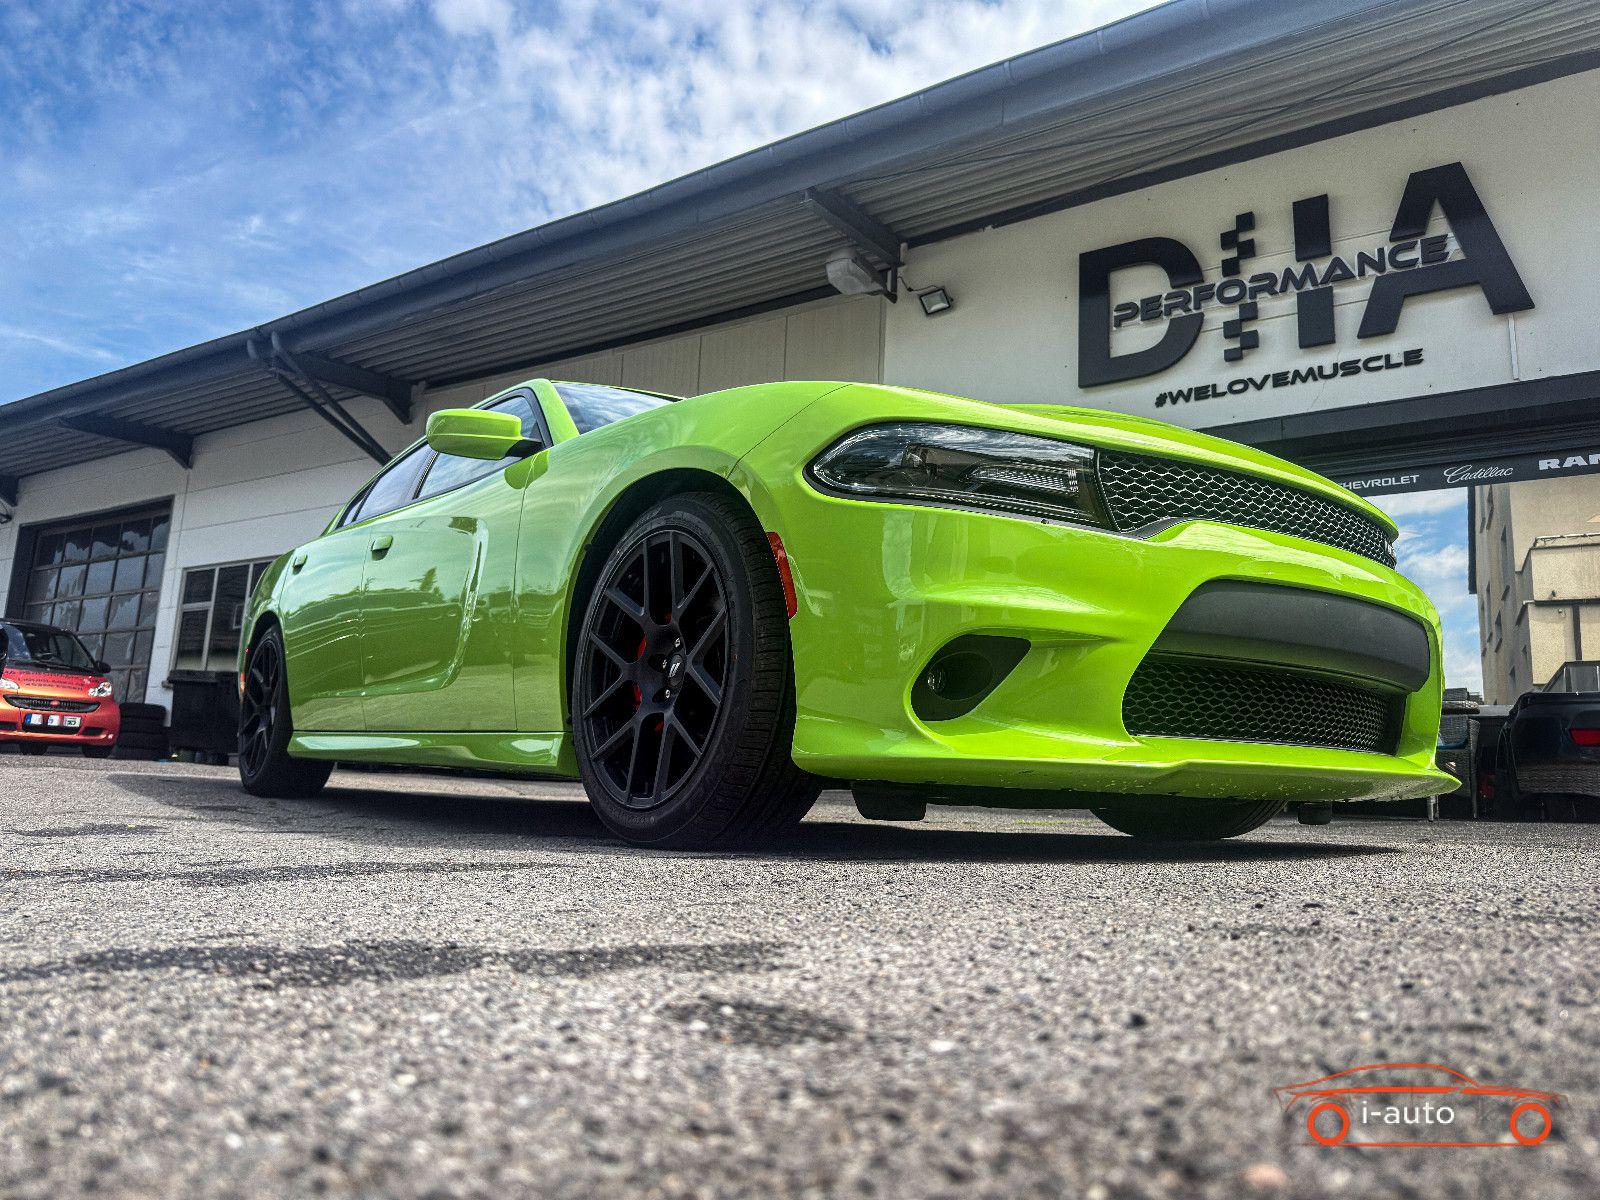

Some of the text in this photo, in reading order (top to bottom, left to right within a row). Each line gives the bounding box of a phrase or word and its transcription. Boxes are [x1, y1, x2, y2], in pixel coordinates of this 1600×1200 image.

[1112, 234, 1455, 328] PERFORMANCE
[1154, 347, 1425, 408] #WELOVEMUSCLE
[1340, 474, 1420, 490] HEVROLET
[1443, 464, 1514, 485] Cadillac
